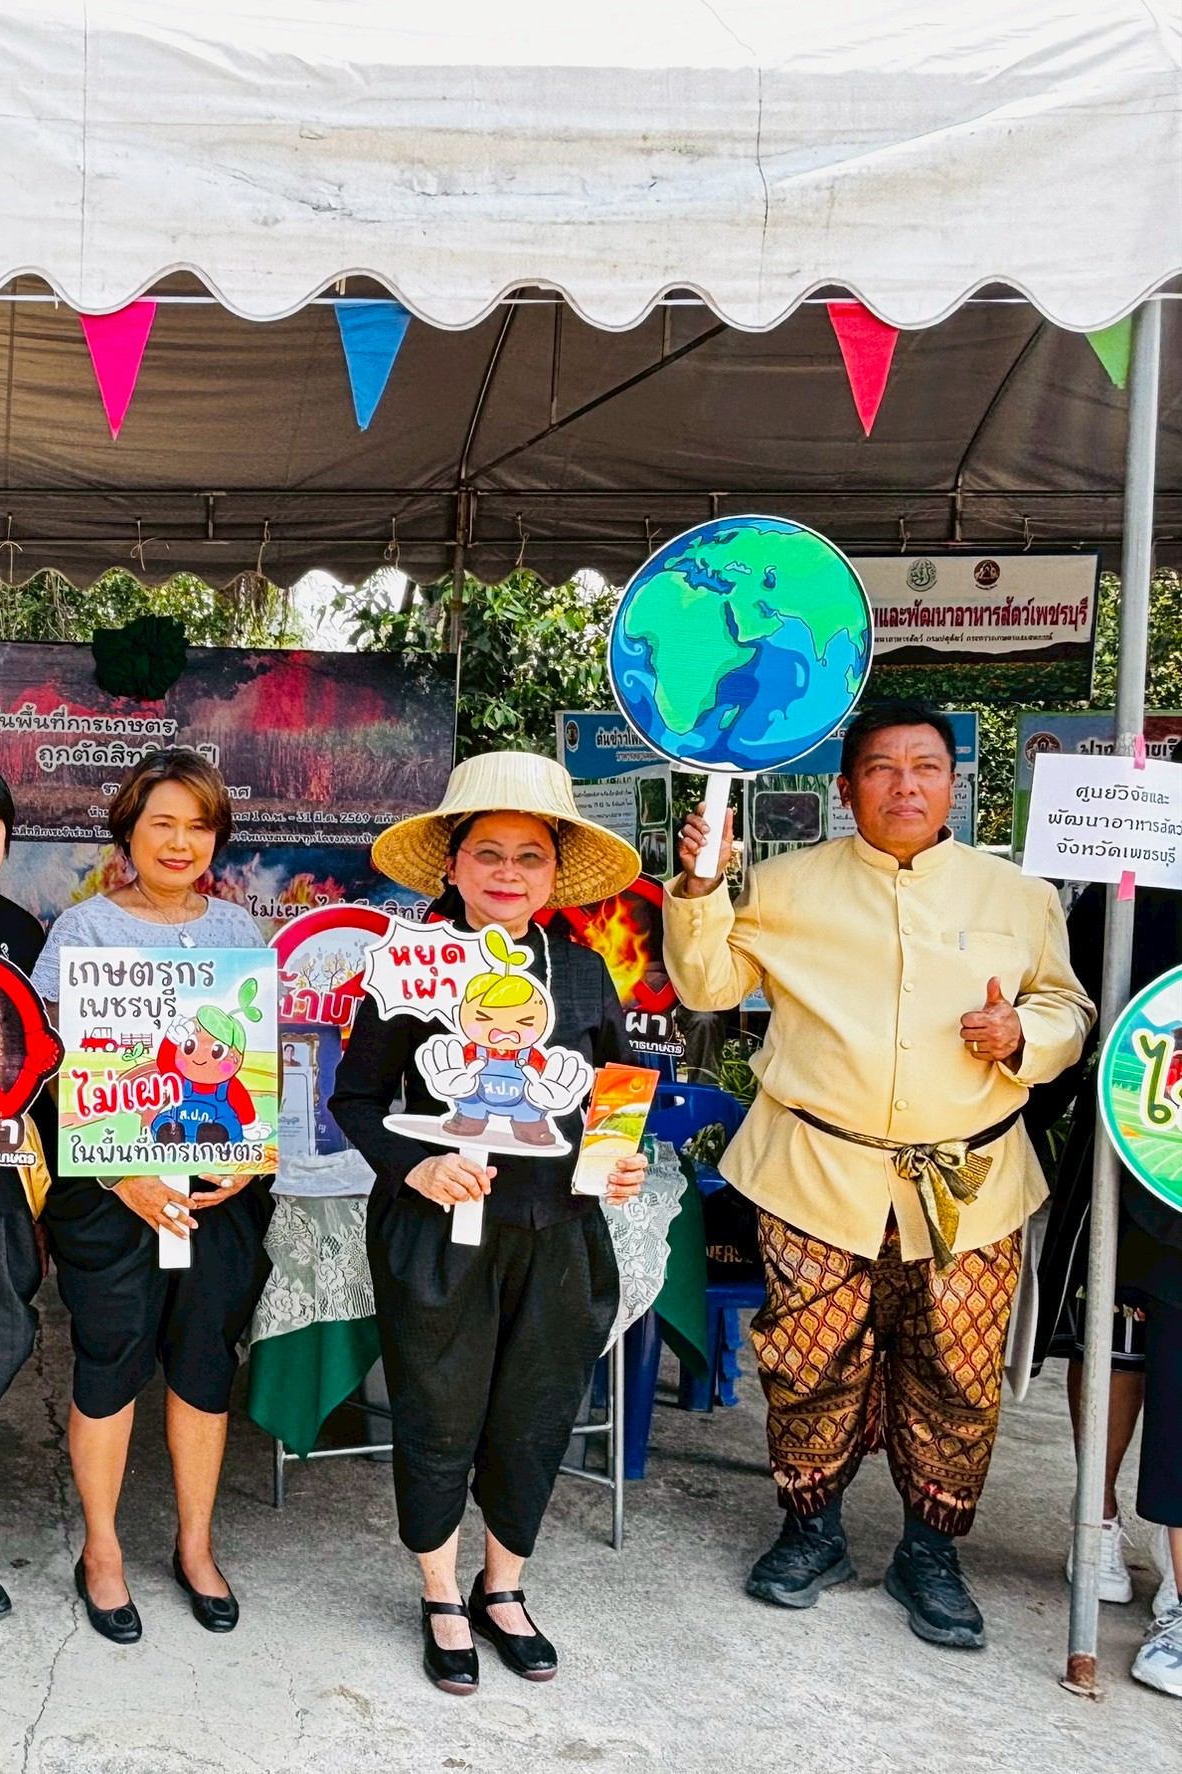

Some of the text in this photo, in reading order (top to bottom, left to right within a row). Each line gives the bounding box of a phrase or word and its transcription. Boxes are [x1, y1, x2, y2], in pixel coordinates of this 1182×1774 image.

[873, 596, 1089, 631] และพัฒนาอาหารสัตว์เพชรบุรี
[1056, 837, 1176, 867] จังหวัดเพชรบุรี
[68, 959, 215, 989] เกษตรกร
[388, 943, 466, 977] หยุด
[402, 977, 458, 1001] เผา
[79, 987, 178, 1030] เพชรบุรี
[73, 1069, 183, 1117] ไม่เผา
[179, 1109, 214, 1124] ส.ป.ก.
[71, 1128, 263, 1164] ในพื้นที่การเกษตร
